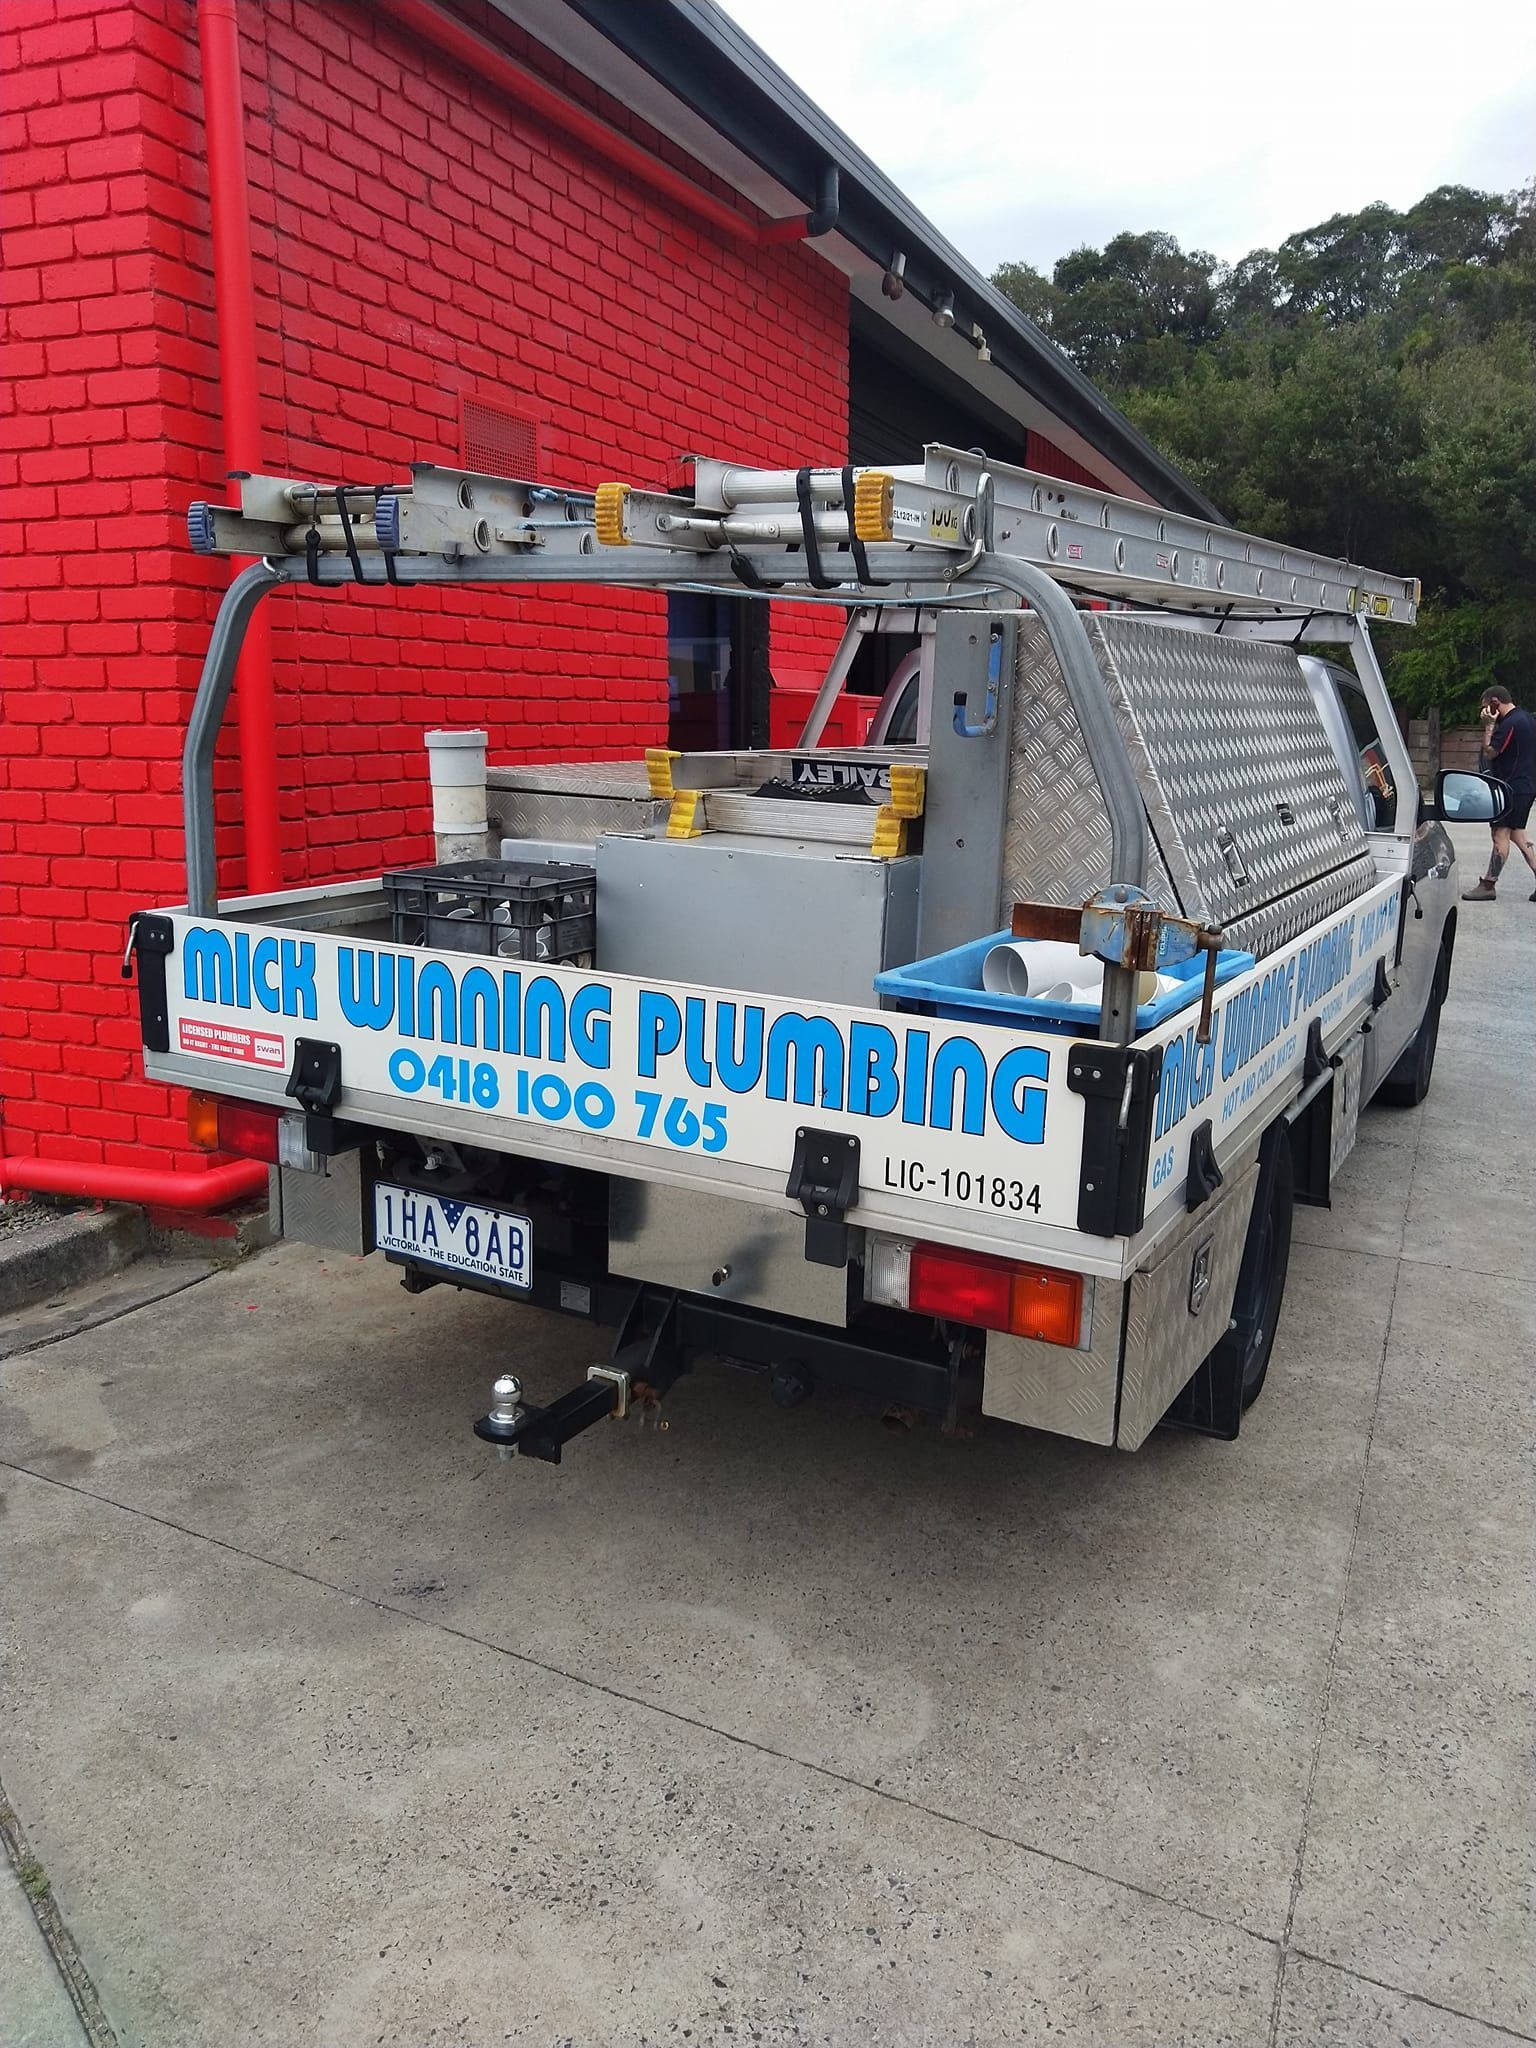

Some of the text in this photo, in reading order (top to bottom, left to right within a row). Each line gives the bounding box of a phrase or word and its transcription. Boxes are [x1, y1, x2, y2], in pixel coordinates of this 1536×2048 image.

[798, 763, 891, 788] BAILEY
[181, 1023, 213, 1039] LICENSED
[183, 926, 1051, 1145] MICK WINNING PLUMBING
[1221, 956, 1296, 1083] WINNING
[256, 1044, 281, 1056] swan
[388, 1048, 728, 1153] 0418 100 765
[1222, 1086, 1239, 1123] HOT
[1240, 1073, 1256, 1107] AND
[1256, 1053, 1275, 1090] COLD
[884, 1157, 1043, 1215] LIC-101834
[1152, 1146, 1175, 1190] GAS
[383, 1235, 421, 1254] VICTORIA
[428, 1247, 445, 1260] THE
[447, 1252, 497, 1275] EDUCATION
[499, 1266, 524, 1282] STATE
[384, 1194, 525, 1270] 1HA 8AB
